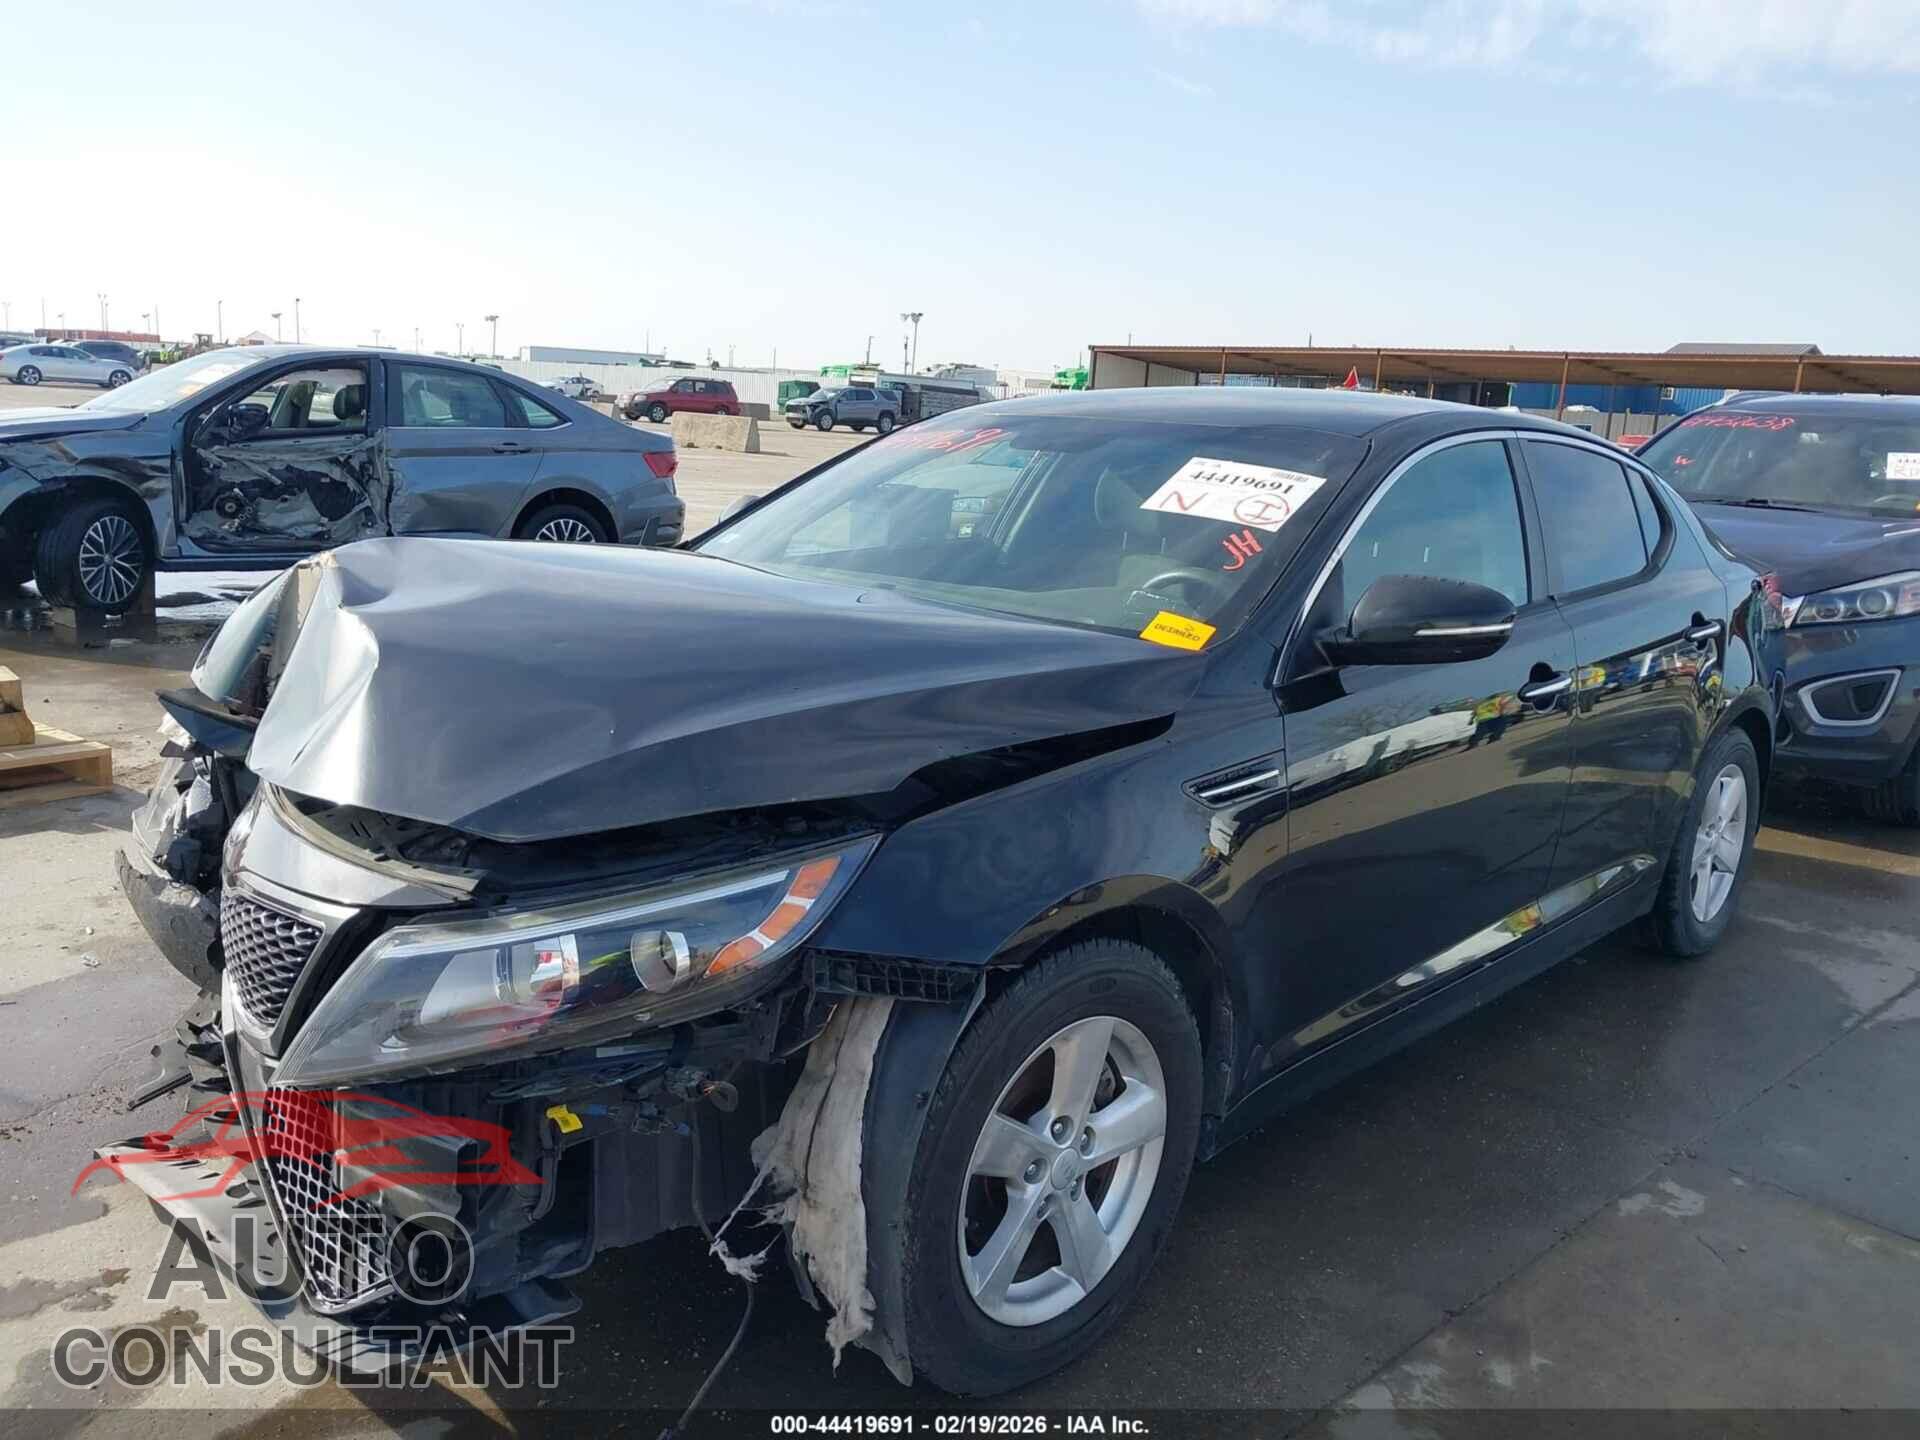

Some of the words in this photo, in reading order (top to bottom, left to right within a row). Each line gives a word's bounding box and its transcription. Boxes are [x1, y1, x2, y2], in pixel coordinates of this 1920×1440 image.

[1190, 471, 1295, 494] 44419691
[1160, 490, 1208, 512] N
[1222, 529, 1263, 570] JH
